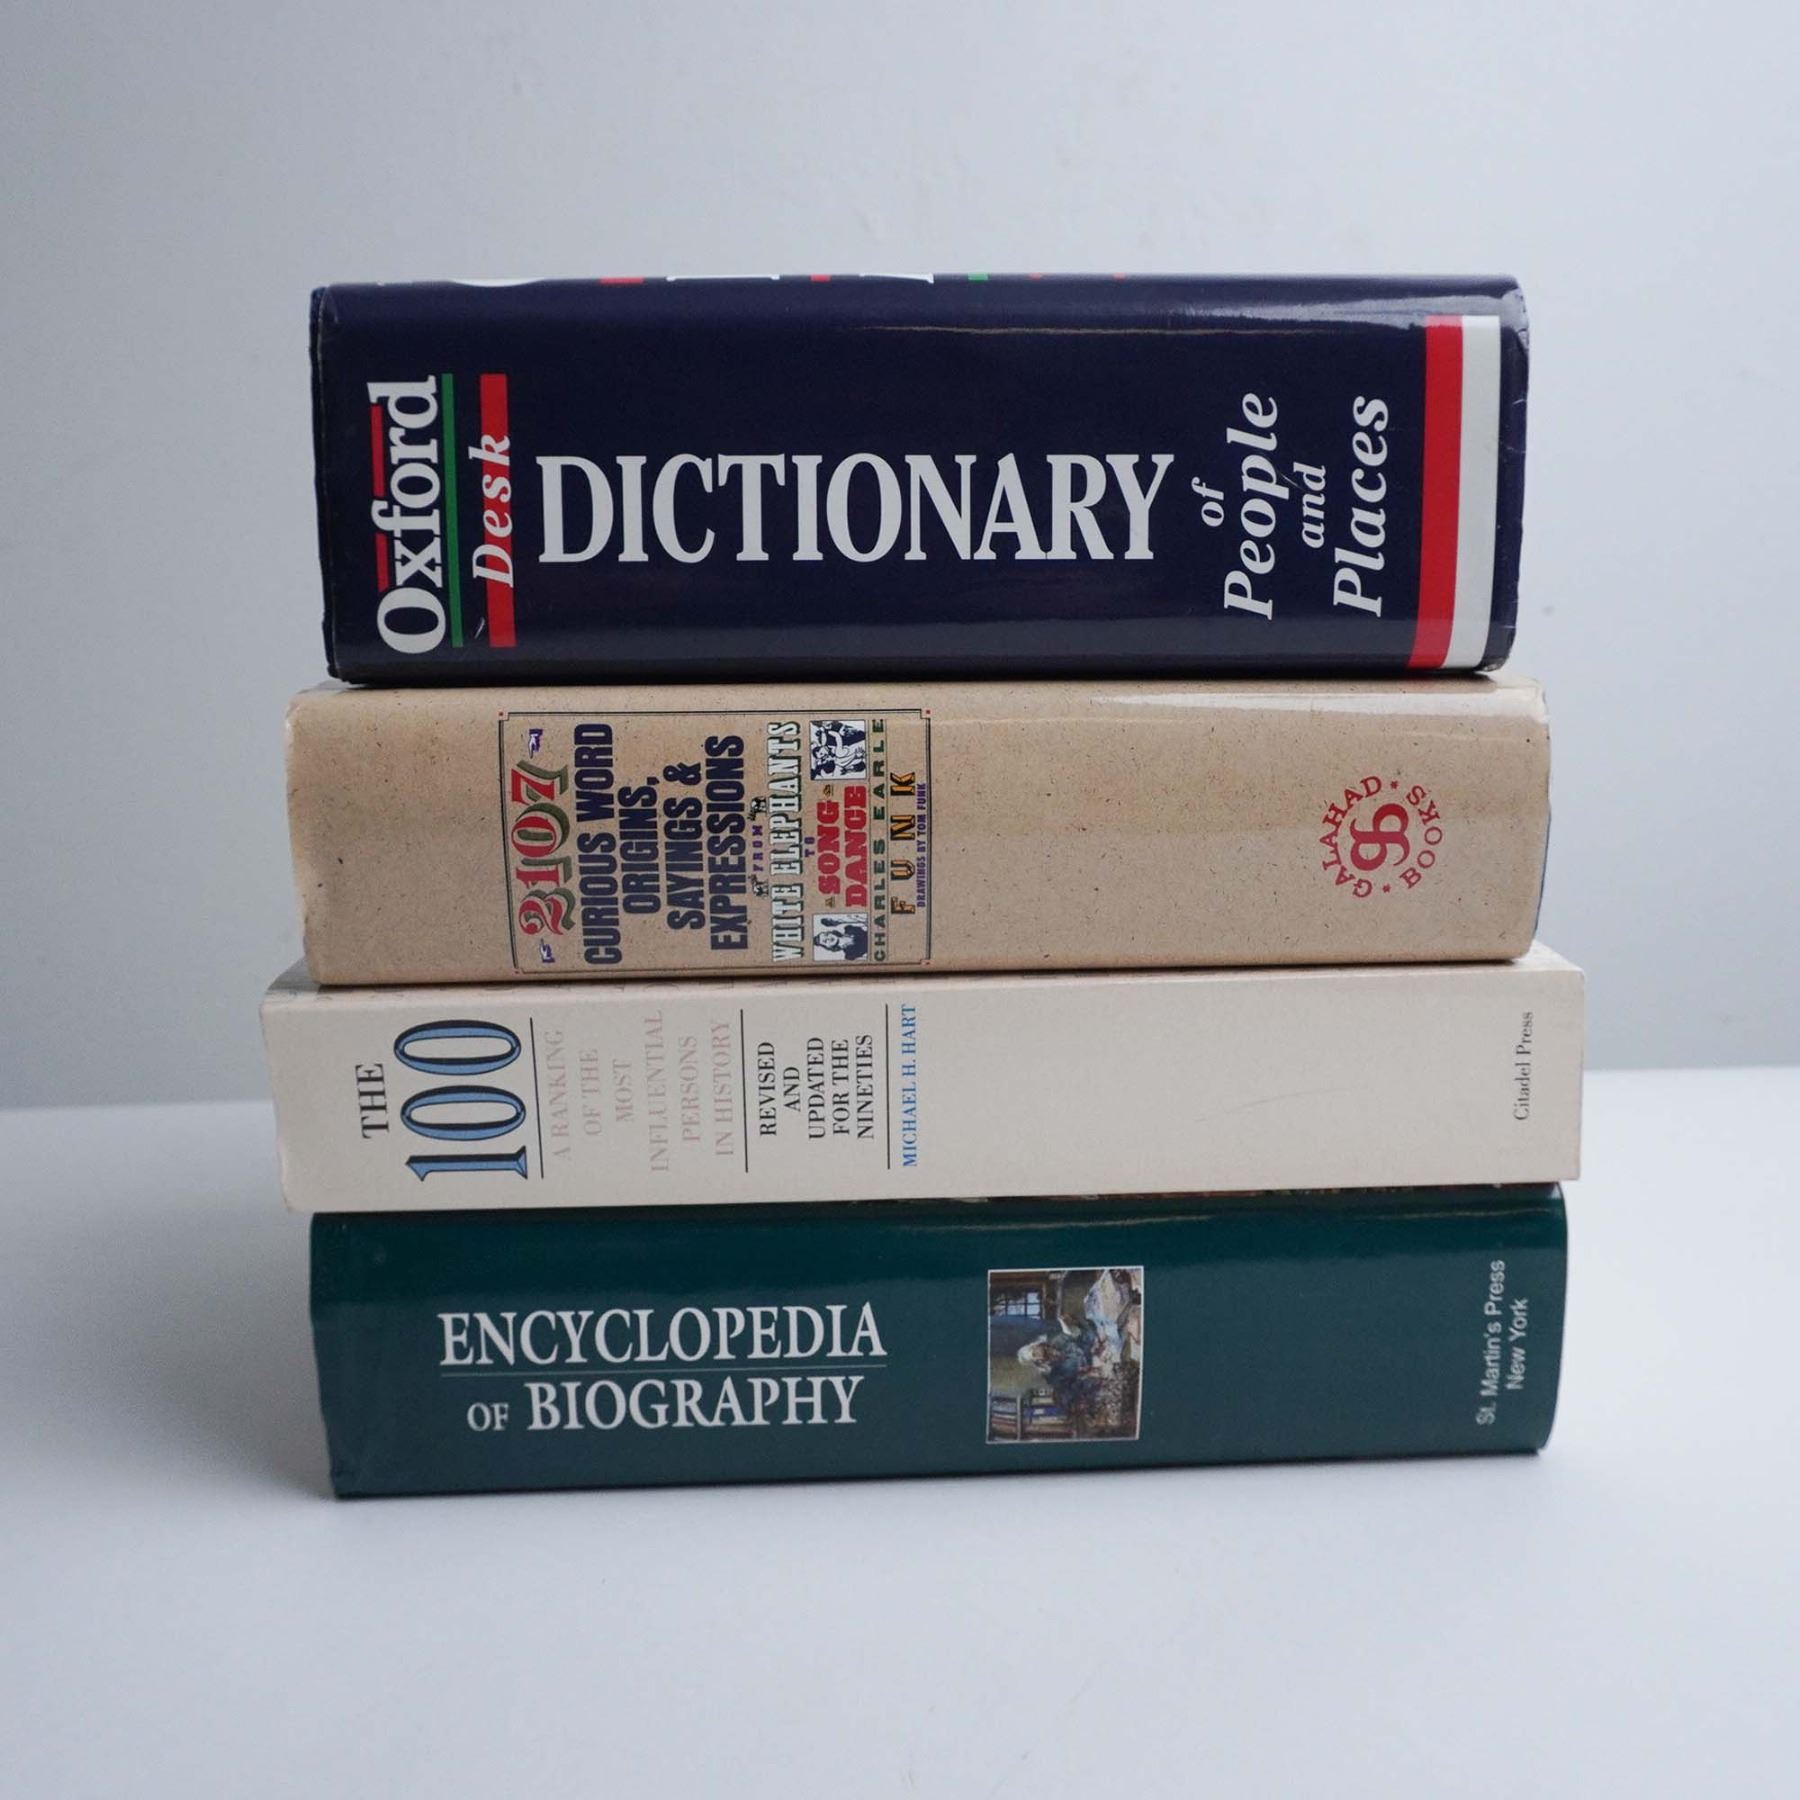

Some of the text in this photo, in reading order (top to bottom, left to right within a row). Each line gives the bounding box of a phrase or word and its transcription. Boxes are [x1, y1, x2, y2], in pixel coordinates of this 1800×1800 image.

[367, 374, 447, 654] Oxford
[468, 434, 515, 588] Desk
[536, 452, 1174, 563] DICTIONARY
[1191, 476, 1225, 527] of
[1223, 392, 1290, 621] People
[1293, 461, 1327, 549] and
[1333, 395, 1389, 618] Places
[511, 760, 576, 936] 2107
[574, 723, 623, 965] CURIOUS WORD
[617, 776, 661, 915] ORIGINS,
[663, 762, 706, 931] SAYINGS &
[704, 735, 749, 951] EXPRESSIONS
[751, 825, 765, 872] FROM
[767, 720, 804, 963] WHITE ELEPHANTS
[804, 836, 816, 858] TO
[816, 800, 840, 895] SONG
[844, 785, 868, 908] DANCE
[872, 718, 886, 962] CHARLES EARLE
[890, 772, 916, 915] FUNK
[916, 783, 927, 908] DRAWINGS BY TOM FUNK
[1319, 776, 1382, 898] GALAHAD
[1399, 785, 1443, 889] BOOKS
[355, 1063, 390, 1140] THE
[394, 1019, 529, 1182] 100
[544, 1030, 571, 1161] A RANKING
[579, 1049, 602, 1137] OF THE
[613, 1058, 635, 1123] MOST
[644, 1009, 669, 1173] INFLUENTIAL
[678, 1035, 701, 1143] PERSONS
[711, 1020, 734, 1156] IN HISTORY
[757, 1041, 778, 1136] REVISED
[783, 1066, 801, 1112] AND
[807, 1037, 826, 1140] UPDATED
[831, 1039, 851, 1136] FOR THE
[855, 1034, 875, 1140] NINETIES
[901, 1004, 918, 1167] MICHAEL H. HART
[1513, 1011, 1533, 1120] Citadel Press
[438, 1301, 888, 1367] ENCYCLOPEDIA
[1484, 1259, 1506, 1317] Press
[1480, 1320, 1503, 1397] Martin's
[1505, 1297, 1530, 1390] New York
[467, 1375, 864, 1432] OF BIOGRAPHY
